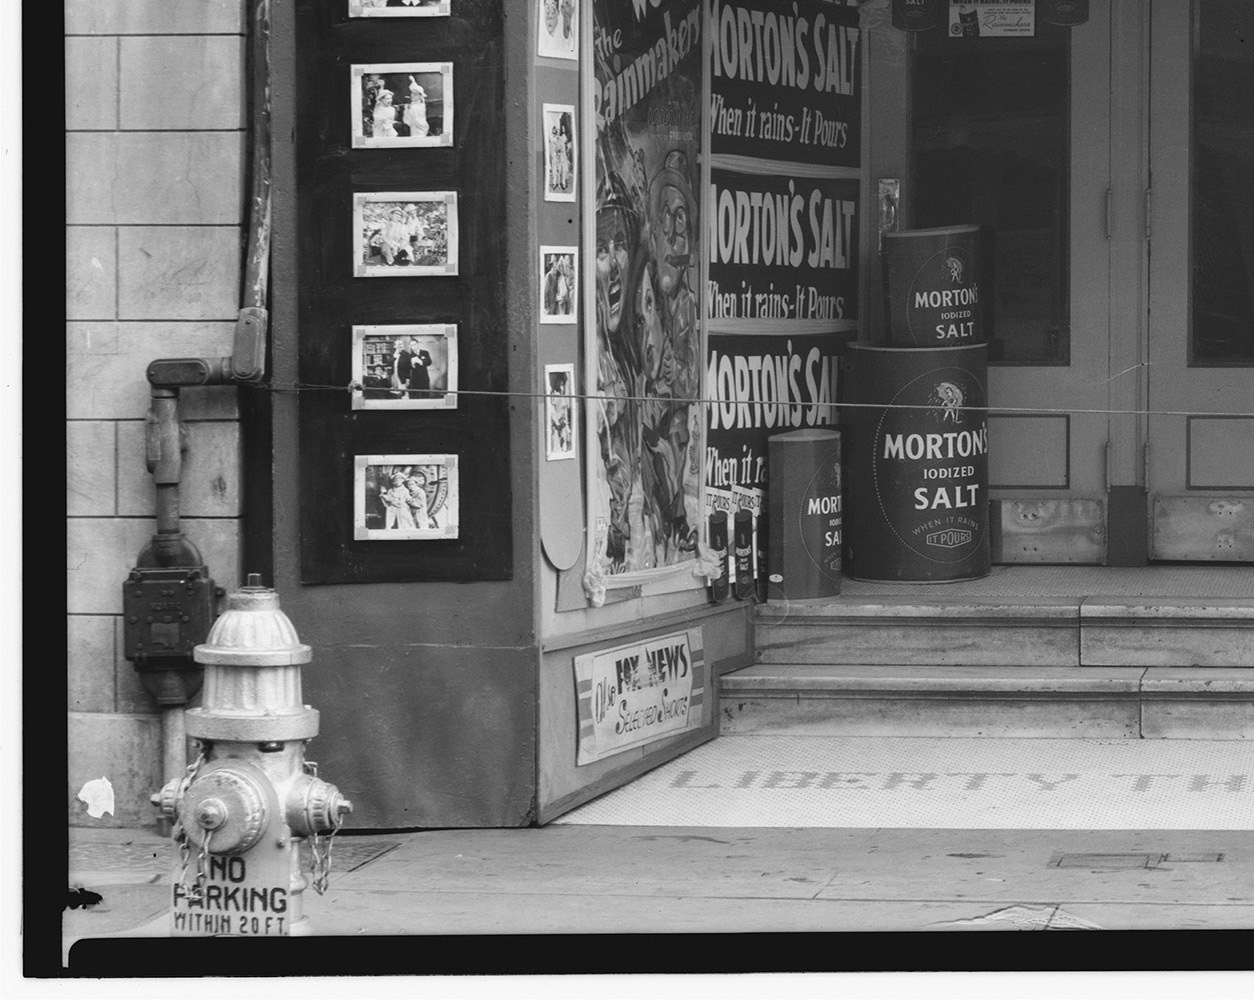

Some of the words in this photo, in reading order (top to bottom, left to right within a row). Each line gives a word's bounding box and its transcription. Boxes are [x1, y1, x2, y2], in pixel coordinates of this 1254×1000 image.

[813, 12, 859, 96] SALT
[711, 93, 743, 136] When
[745, 97, 757, 138] it
[813, 109, 848, 148] Pours
[807, 188, 855, 269] SALT
[708, 280, 737, 319] When
[741, 280, 752, 319] it
[807, 286, 845, 319] Pours
[914, 282, 979, 309] MORTON'S
[940, 310, 972, 320] IODIZED
[935, 321, 975, 340] SALT
[805, 346, 840, 427] SAL
[883, 421, 988, 460] MORTON'S
[741, 444, 752, 484] it
[923, 465, 975, 480] IODIZED
[807, 495, 841, 516] MORT
[913, 483, 980, 510] SALT
[911, 517, 942, 536] WHEN
[945, 516, 955, 524] IT
[957, 516, 980, 531] RAINS
[929, 535, 938, 543] IT
[940, 531, 970, 545] POURS
[615, 655, 642, 695] FOX
[645, 643, 688, 688] NEWS
[666, 768, 1081, 793] LIBERTY
[209, 855, 246, 884] NO
[173, 884, 288, 914] PARKING
[173, 911, 232, 935] WITHIN
[239, 915, 260, 935] 20
